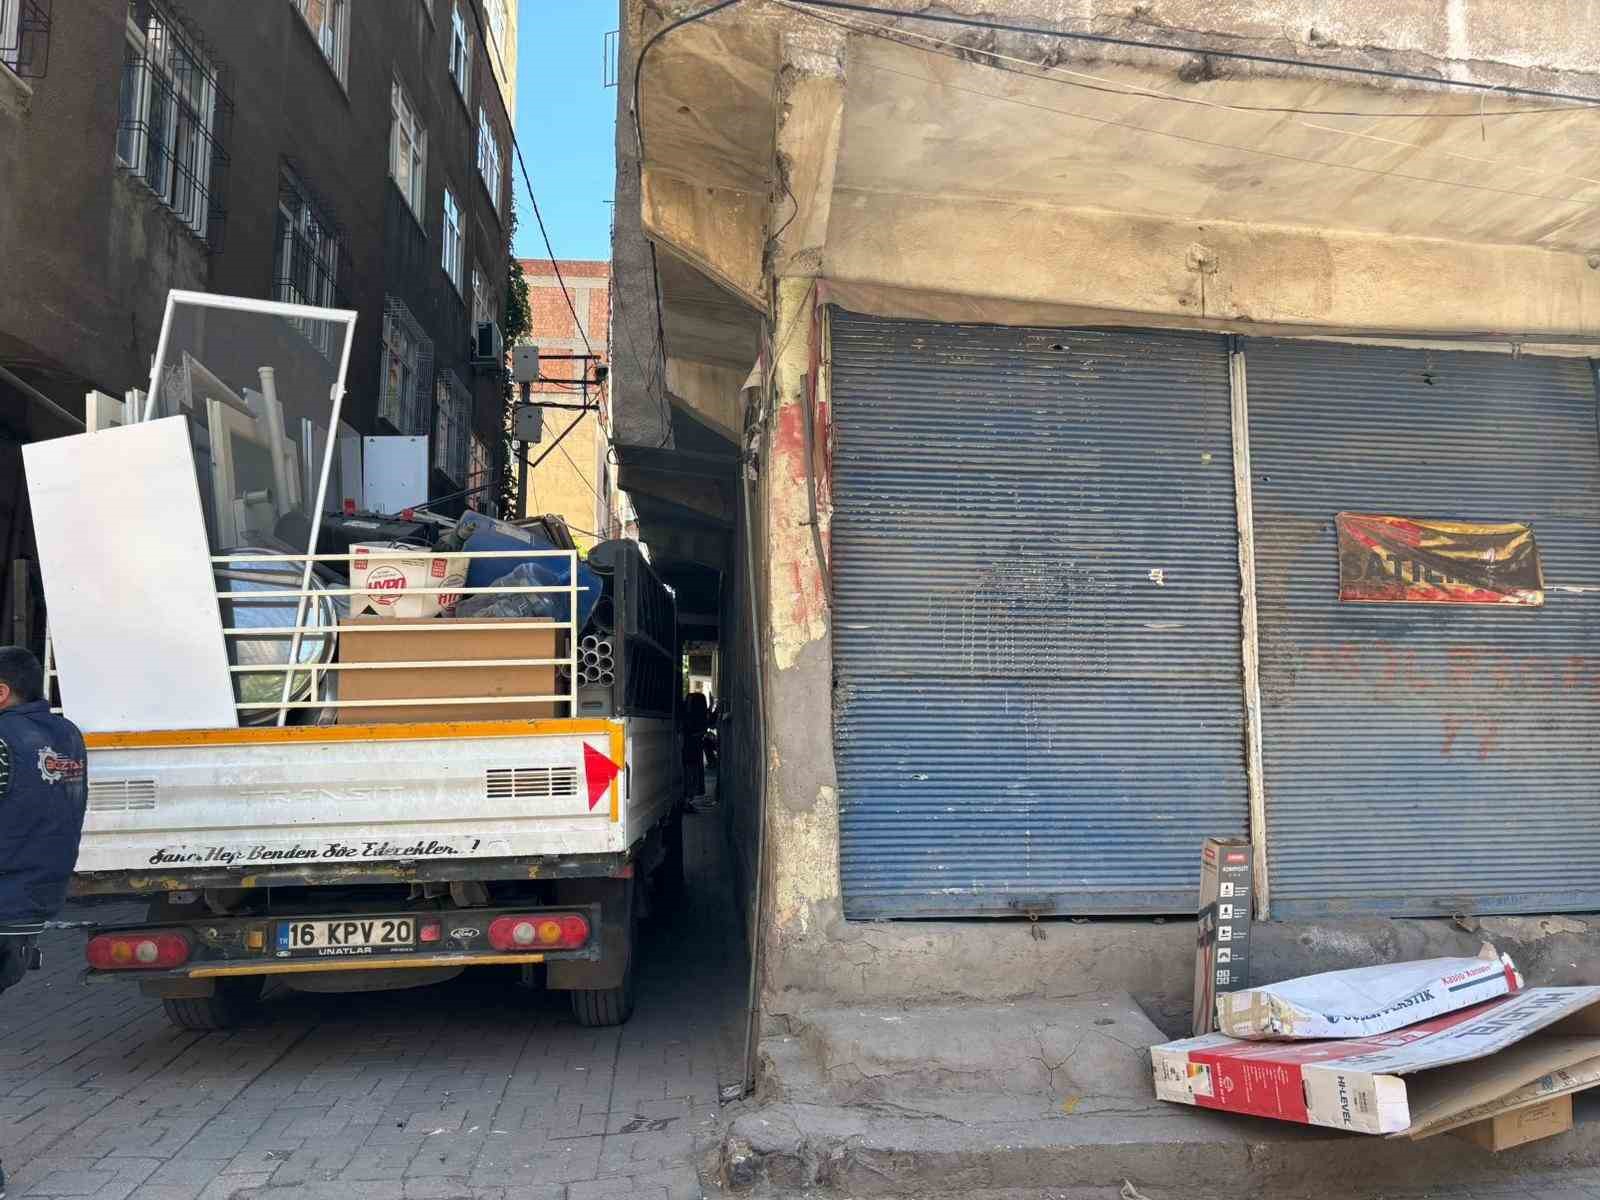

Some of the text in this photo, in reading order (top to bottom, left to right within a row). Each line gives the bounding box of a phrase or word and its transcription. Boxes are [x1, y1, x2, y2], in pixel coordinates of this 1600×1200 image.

[246, 843, 320, 860] Benden
[290, 920, 411, 946] 16 KPV 20
[319, 946, 372, 956] UNATLAR
